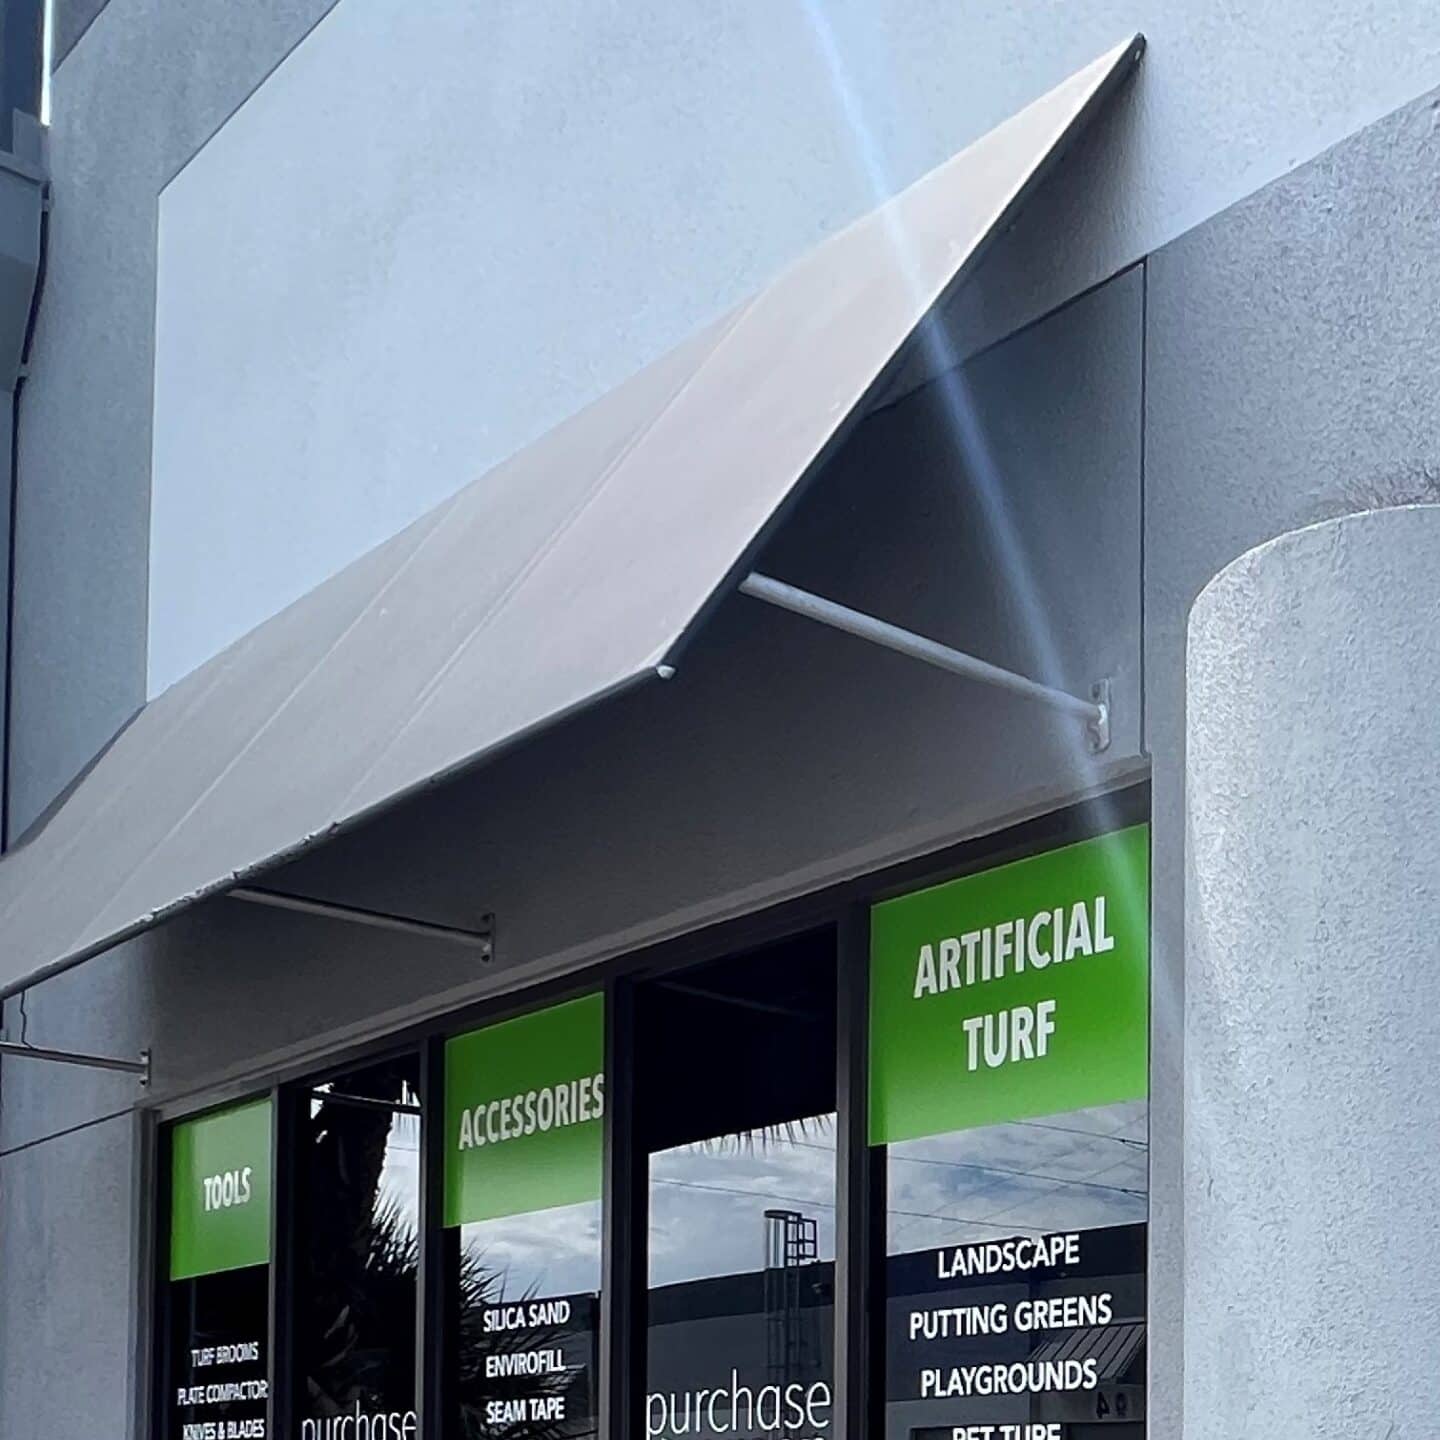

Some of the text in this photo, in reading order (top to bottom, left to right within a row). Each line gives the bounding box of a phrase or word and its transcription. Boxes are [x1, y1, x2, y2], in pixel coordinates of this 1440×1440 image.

[913, 896, 1115, 998] ARTIFICIAL
[962, 999, 1056, 1071] TURF
[458, 1073, 605, 1150] ACCESSORIES
[203, 1166, 252, 1211] TOOLS
[938, 1234, 1080, 1279] LANDSCAPE
[483, 1300, 570, 1332] SILICA SAND
[909, 1293, 1113, 1340] PUTTING GREENS
[485, 1349, 567, 1378] ENVIROFILL
[921, 1358, 1098, 1398] PLAYGROUNDS
[486, 1396, 565, 1424] SEAM TAPE
